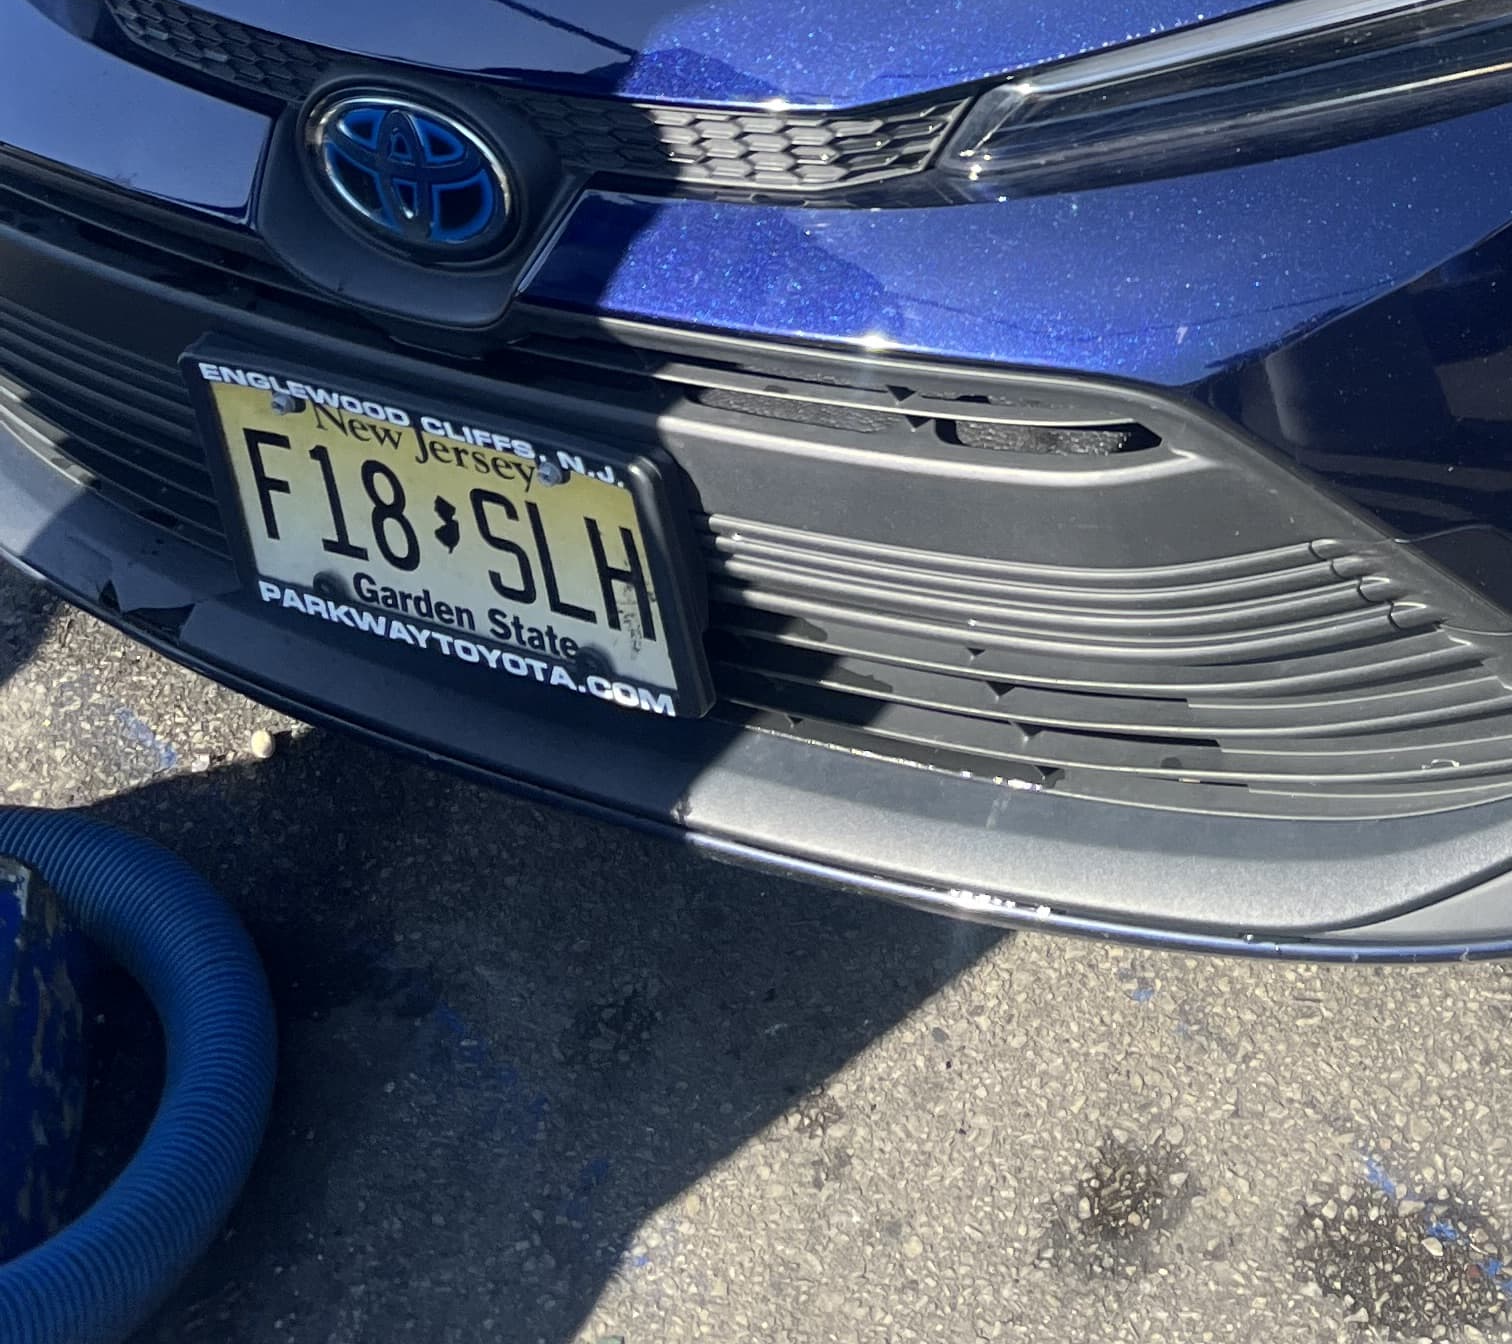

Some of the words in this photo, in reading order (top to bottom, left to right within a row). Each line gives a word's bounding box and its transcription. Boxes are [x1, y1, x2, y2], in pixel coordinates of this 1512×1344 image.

[199, 362, 410, 428] ENGLEWOOD
[559, 450, 626, 487] N.J.
[312, 398, 404, 452] New
[413, 424, 537, 493] Jersey
[258, 579, 677, 718] PARKWAYTOYOTA.COM
[352, 571, 476, 633] Garden
[488, 609, 581, 661] State
